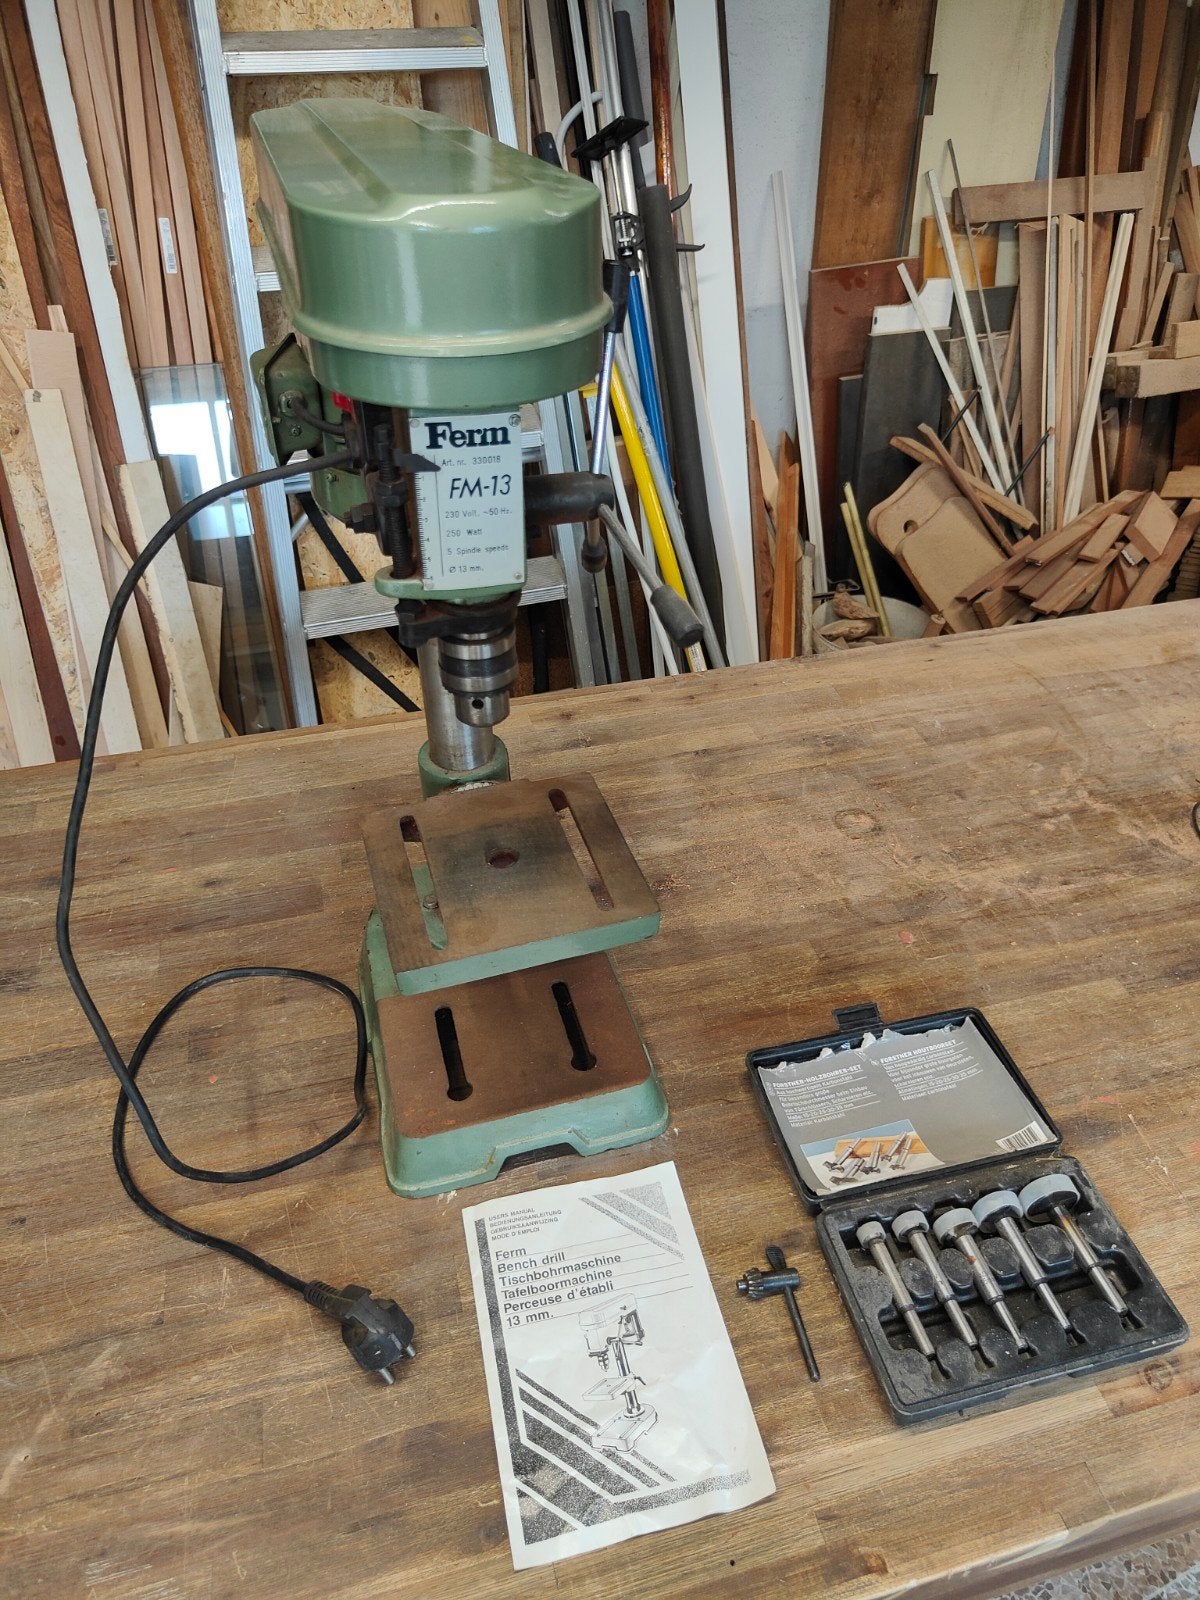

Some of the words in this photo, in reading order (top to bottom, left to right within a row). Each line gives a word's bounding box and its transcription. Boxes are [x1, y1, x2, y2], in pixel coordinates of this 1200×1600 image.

[424, 421, 511, 450] Ferm
[442, 459, 455, 467] Art.
[472, 455, 501, 465] 330018
[450, 474, 512, 499] FM-13
[445, 510, 460, 519] 230
[446, 530, 461, 538] 250
[466, 528, 483, 536] Watt
[447, 548, 452, 556] 5
[456, 546, 481, 556] Spindle
[485, 545, 509, 553] speeds
[459, 565, 467, 573] 13
[488, 1213, 509, 1222] USERS
[510, 1208, 535, 1217] MANUAL
[491, 1232, 510, 1241] MODE
[495, 1247, 527, 1260] Ferm
[497, 1257, 537, 1273] Bench
[542, 1252, 566, 1267] drill
[499, 1253, 621, 1287] Tischbohrmaschine
[501, 1268, 613, 1300] Tafelboormachine
[503, 1293, 563, 1314] Perceuse
[567, 1280, 614, 1300] d'établi
[506, 1314, 521, 1327] 13
[525, 1309, 554, 1323] mm.
